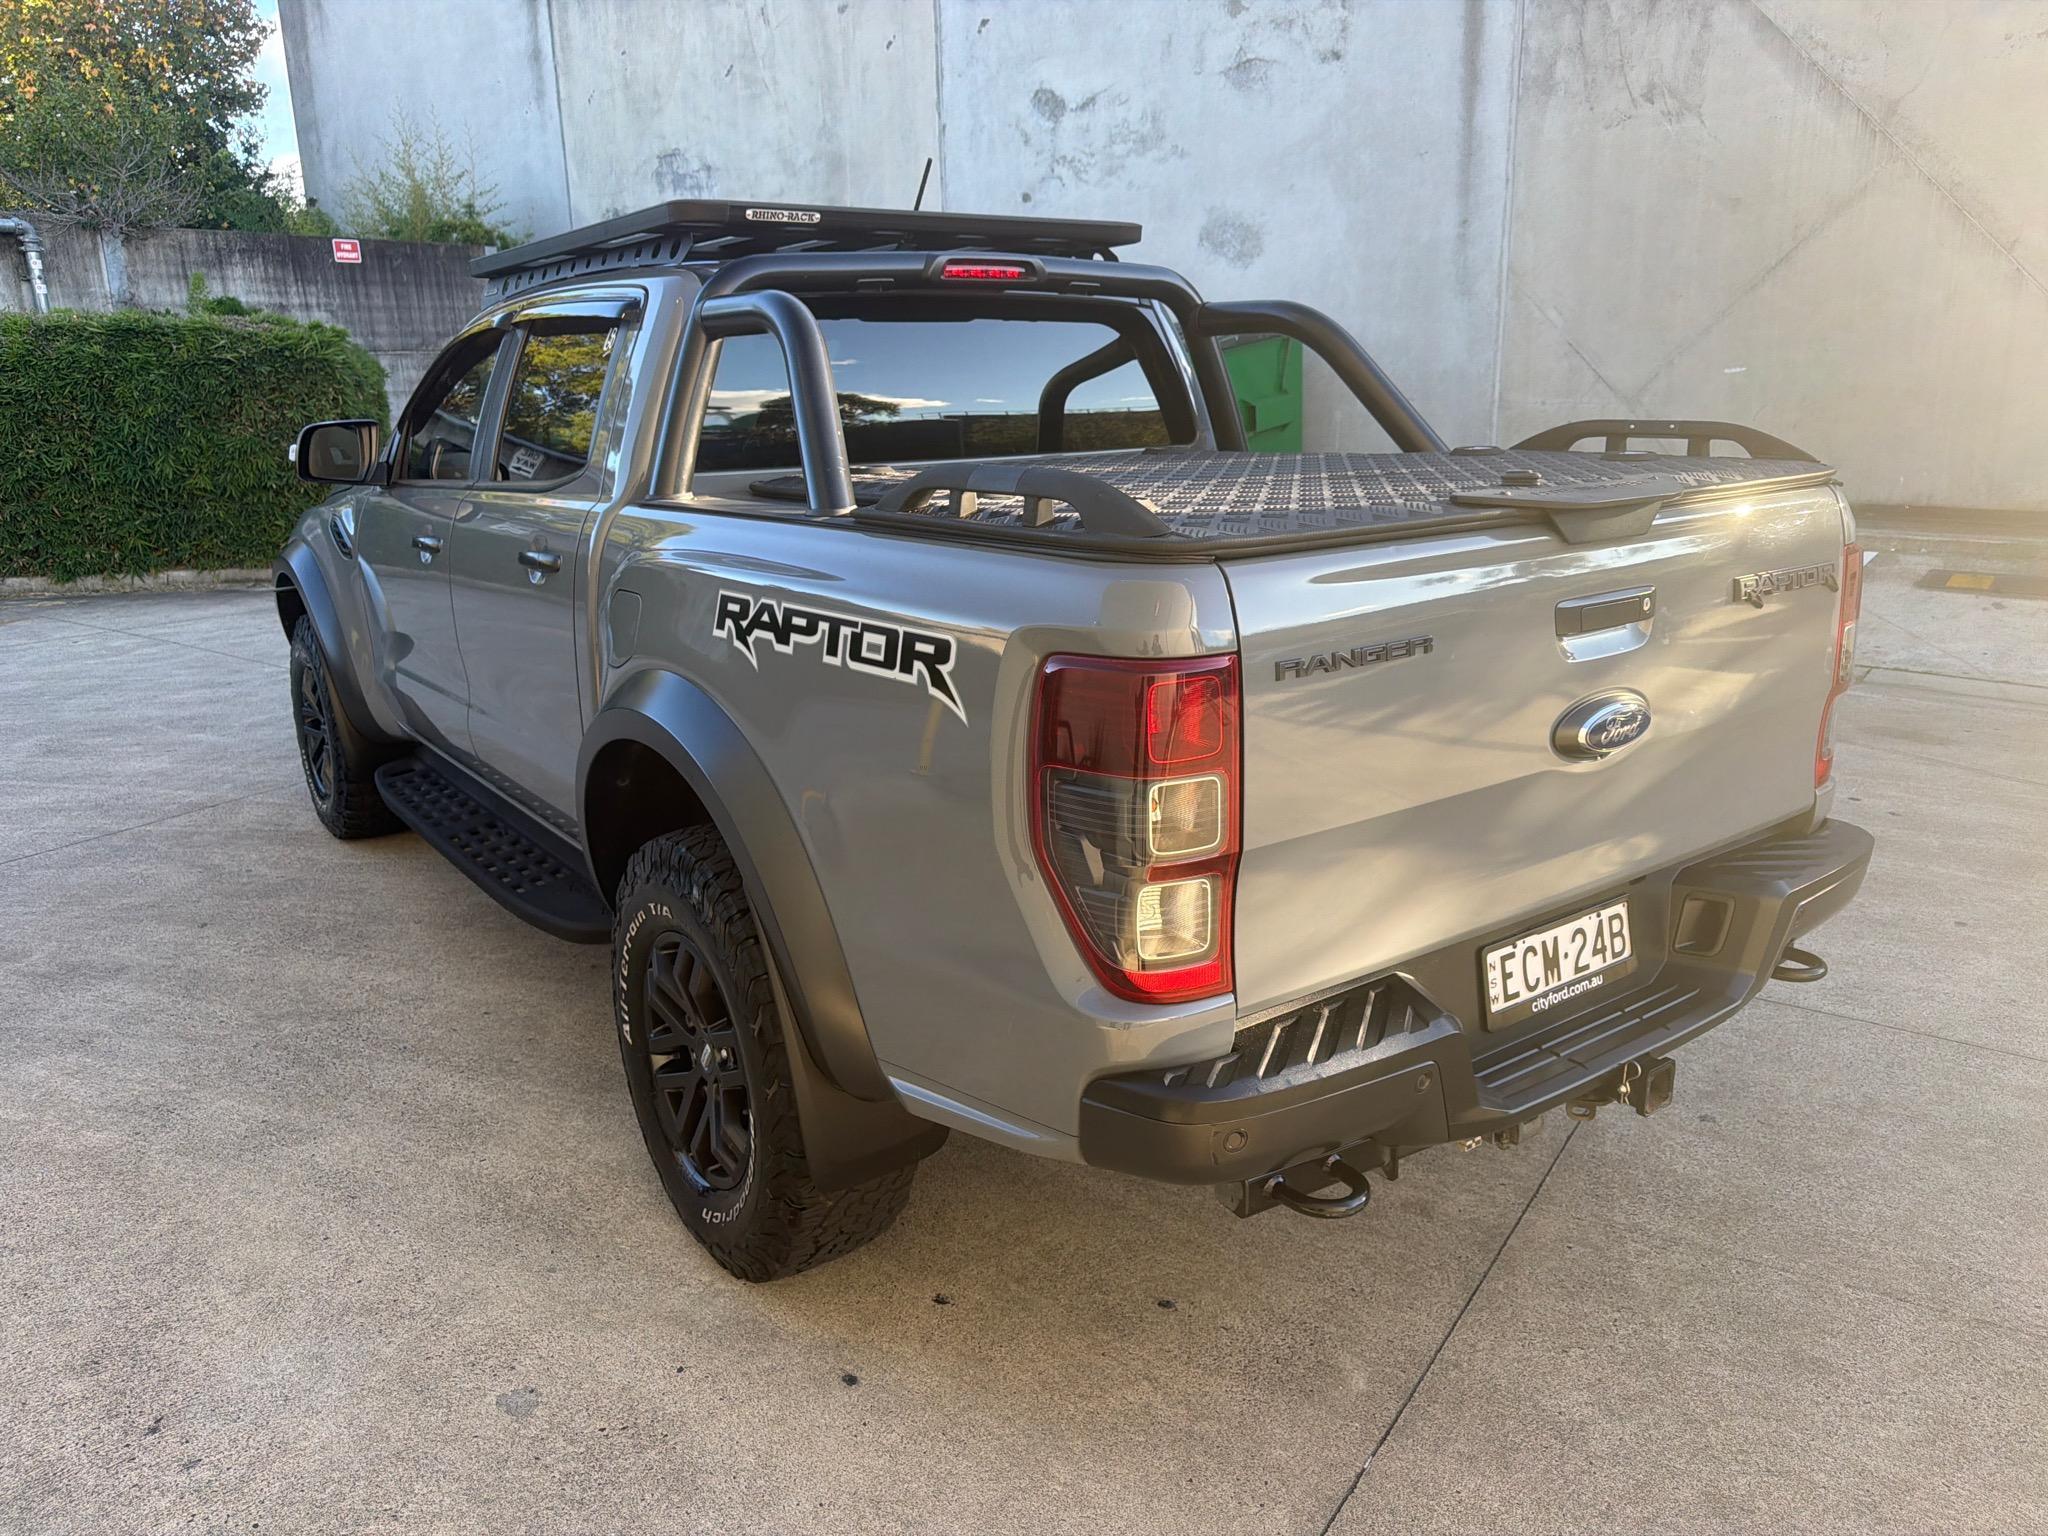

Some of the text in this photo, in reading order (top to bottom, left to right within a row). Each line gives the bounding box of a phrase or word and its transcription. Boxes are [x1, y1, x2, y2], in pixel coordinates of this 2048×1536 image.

[751, 210, 816, 222] RHINO-RACK
[1733, 561, 1838, 609] RAPTOR
[712, 589, 969, 728] RAPTOR
[1274, 634, 1434, 682] RANGER
[1600, 711, 1642, 745] Ford
[1531, 973, 1604, 1013] cityford.com.au
